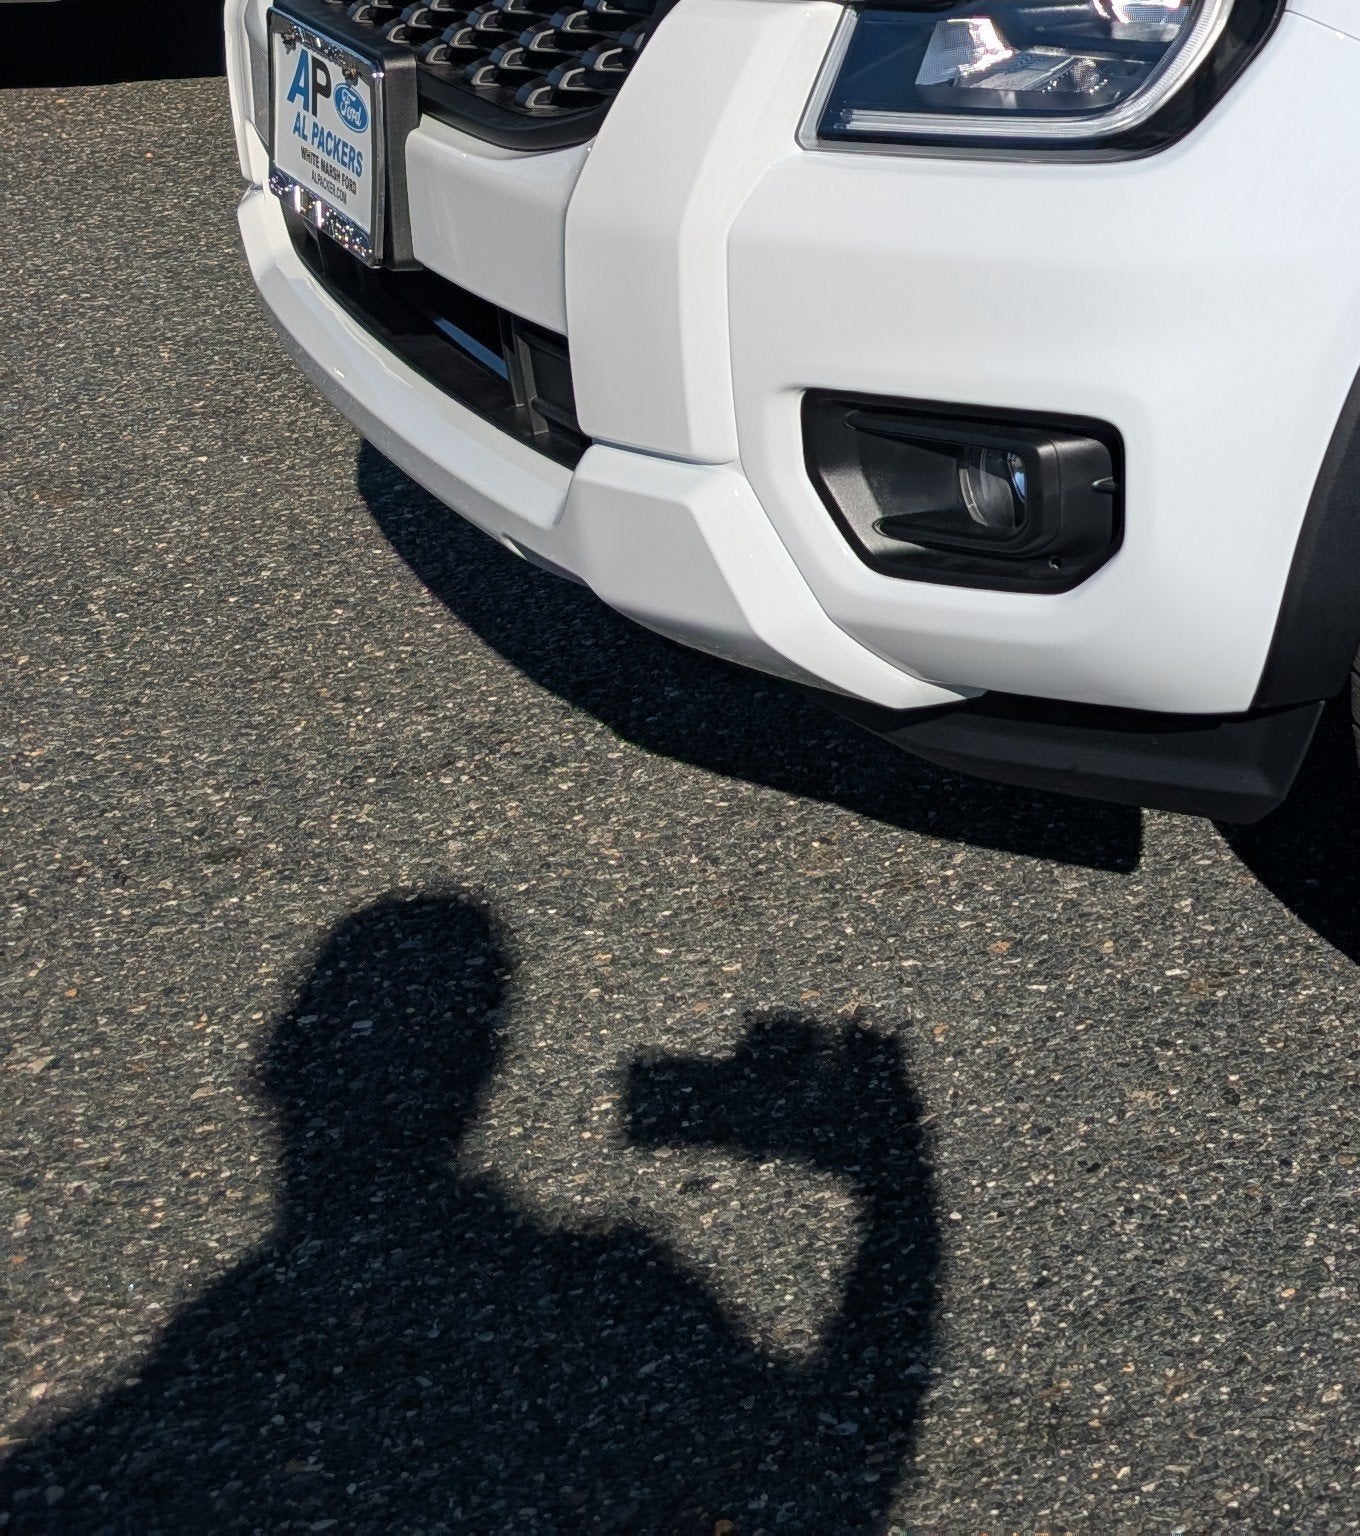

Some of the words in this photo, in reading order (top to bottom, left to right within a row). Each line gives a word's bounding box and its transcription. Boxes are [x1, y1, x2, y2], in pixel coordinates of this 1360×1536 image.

[286, 48, 332, 118] AP
[292, 111, 308, 142] AL
[311, 120, 364, 178] PACKERS
[341, 172, 357, 195] FORD
